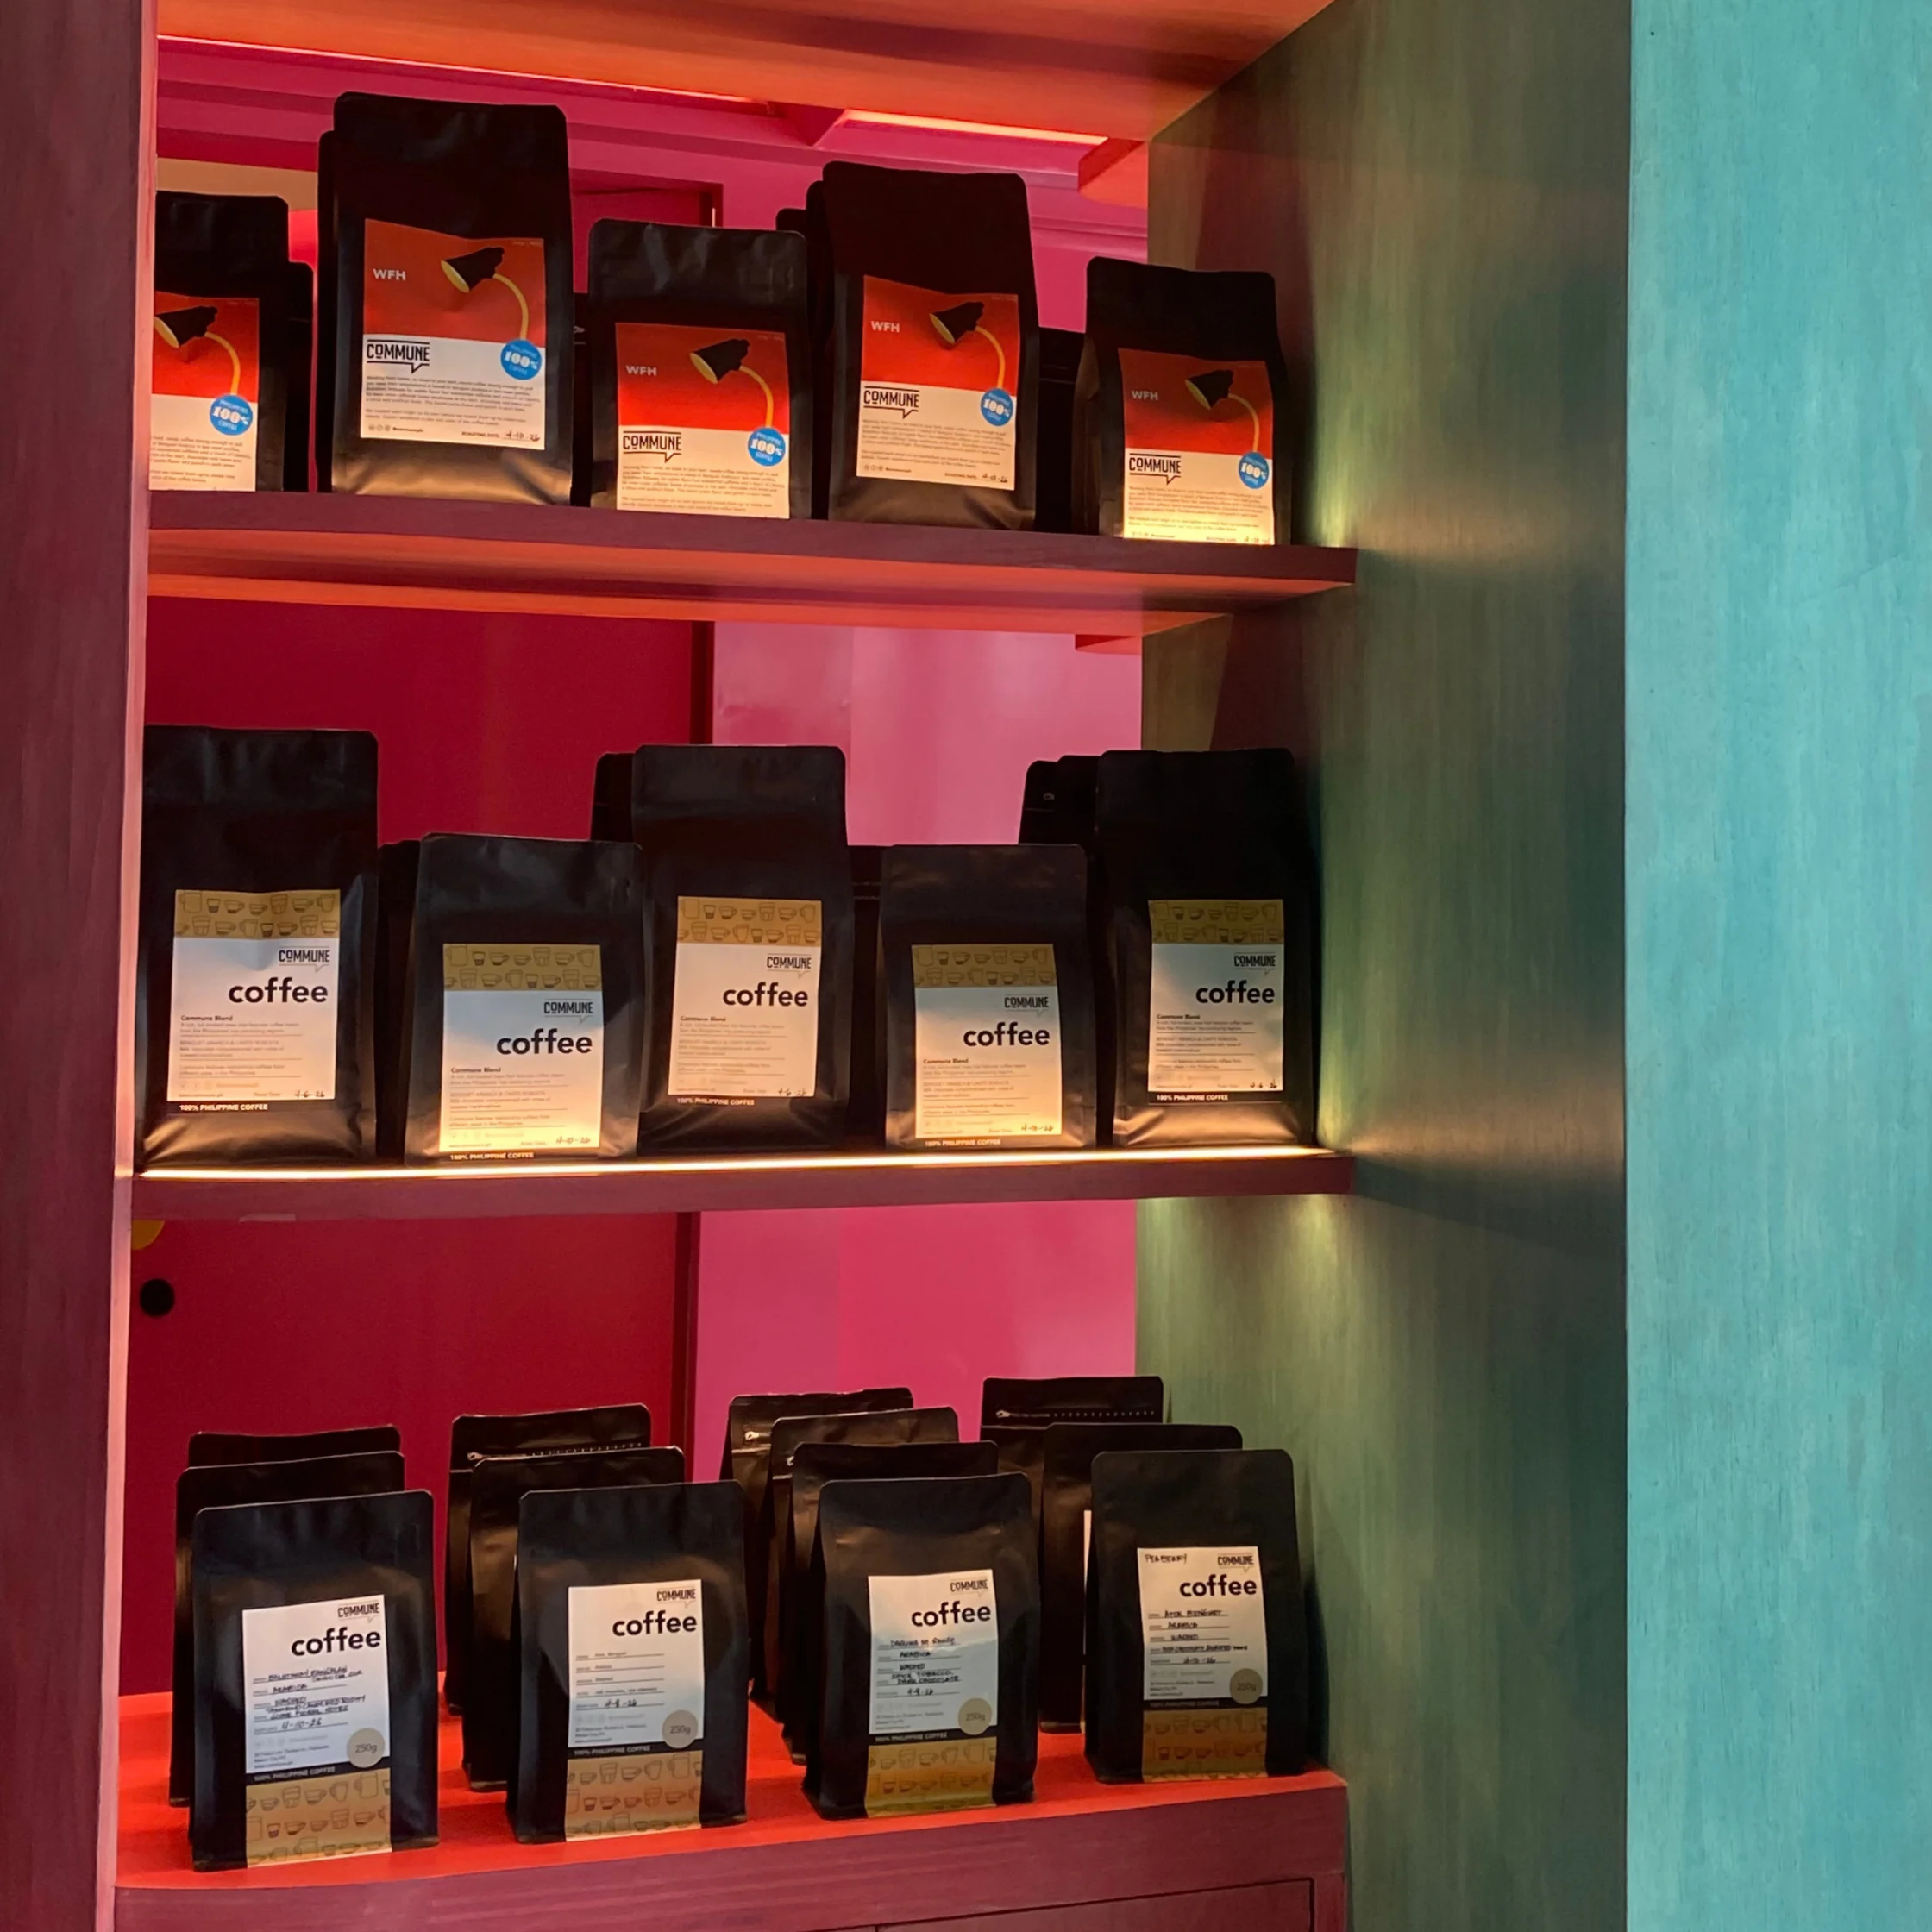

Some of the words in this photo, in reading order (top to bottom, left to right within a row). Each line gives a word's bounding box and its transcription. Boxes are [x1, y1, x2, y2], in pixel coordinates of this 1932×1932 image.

[373, 267, 406, 281] WFH
[871, 321, 900, 333] WFH
[367, 343, 430, 361] COMMUNE
[505, 350, 538, 370] 100%
[625, 364, 657, 376] WFH
[864, 390, 919, 407] COMMUNE
[1132, 390, 1159, 400] WFH
[212, 406, 250, 425] 100%
[983, 398, 1010, 417] 100%
[623, 435, 681, 450] COMMUNE
[750, 438, 782, 456] 100%
[1130, 457, 1182, 473] COMMUNE
[1241, 462, 1267, 480] 100%
[279, 950, 329, 963] COMMUNE
[767, 957, 811, 969] COMMUNE
[1234, 955, 1276, 967] COMMUNE
[229, 977, 328, 1003] coffee
[723, 982, 808, 1007] coffee
[1196, 980, 1275, 1004] coffee
[544, 1002, 593, 1014] COMMUNE
[1005, 996, 1049, 1008] COMMUNE
[497, 1028, 593, 1055] coffee
[963, 1021, 1050, 1046] coffee
[1218, 1556, 1253, 1565] COMMUNE
[950, 1579, 988, 1592] COMMUNE
[1180, 1574, 1257, 1596] coffee
[657, 1589, 695, 1602] COMMUNE
[338, 1603, 380, 1617] COMMUNE
[912, 1601, 990, 1627] coffee
[612, 1610, 697, 1636] coffee
[292, 1627, 380, 1656] coffee
[670, 1726, 691, 1734] 250g
[355, 1744, 377, 1754] 250g
